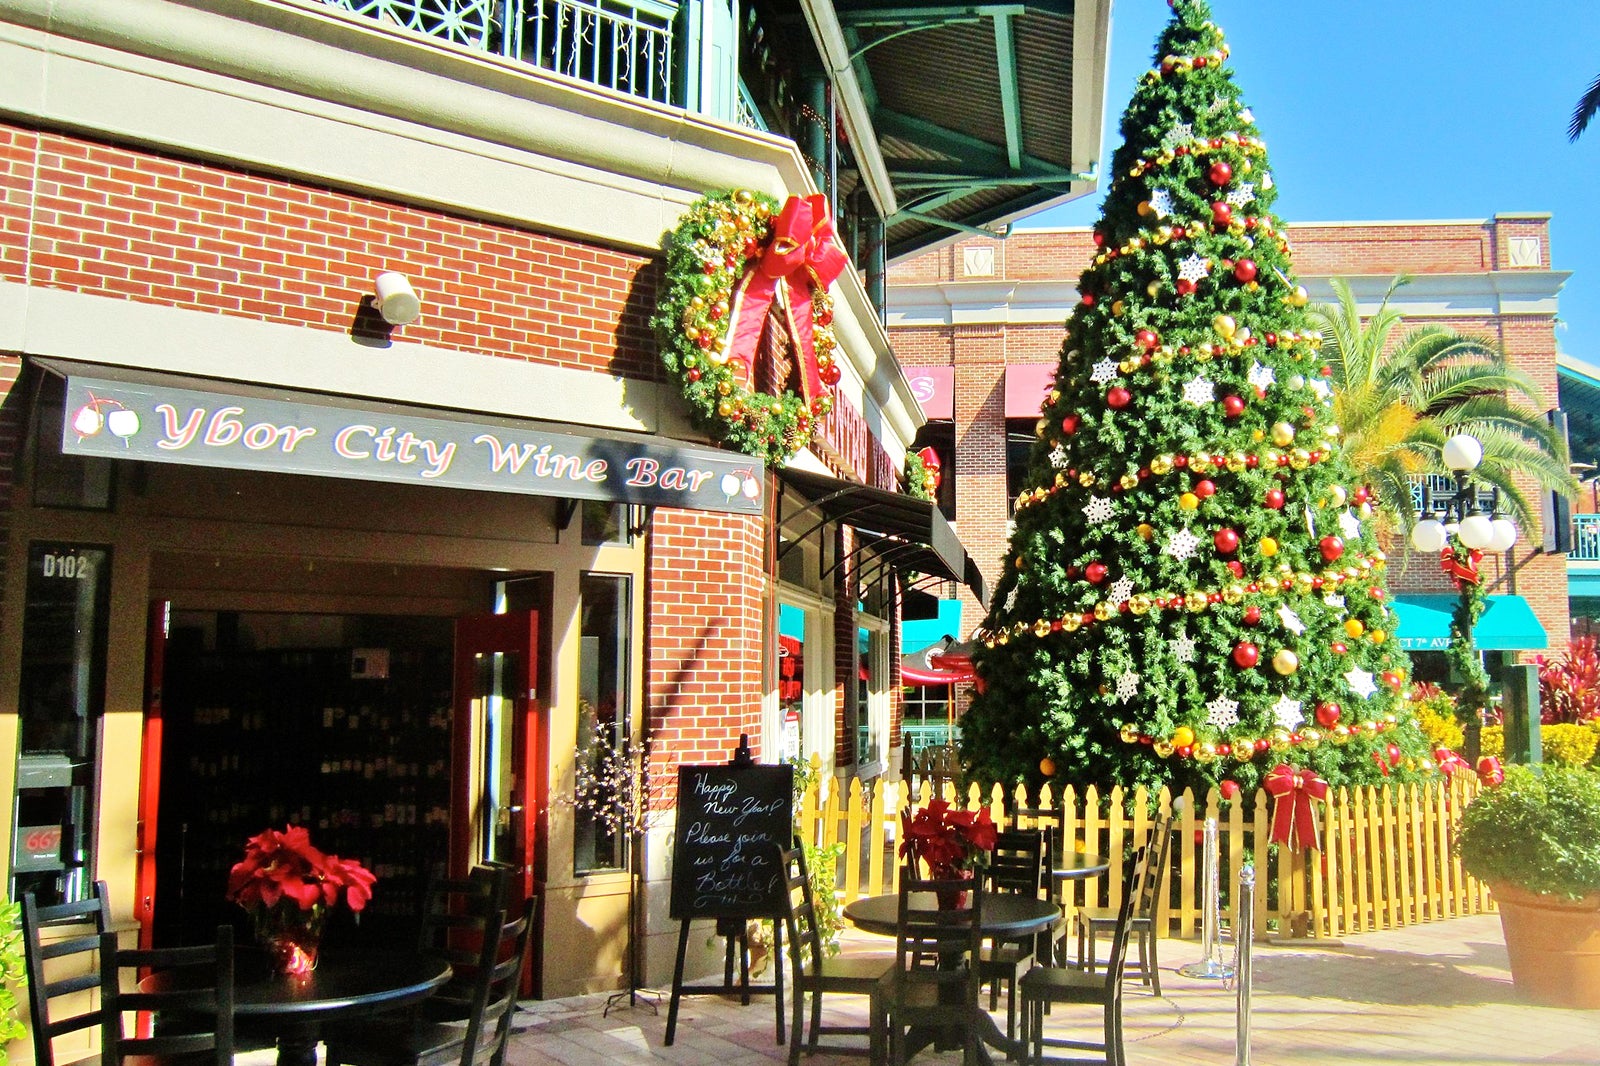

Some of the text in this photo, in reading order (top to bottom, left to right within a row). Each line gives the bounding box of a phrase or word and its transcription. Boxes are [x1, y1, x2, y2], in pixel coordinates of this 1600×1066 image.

[155, 404, 714, 492] Ybor City Wine Bar
[43, 554, 87, 578] D102
[694, 773, 738, 801] Happy
[685, 822, 772, 850] Please join
[693, 849, 768, 871] us for a
